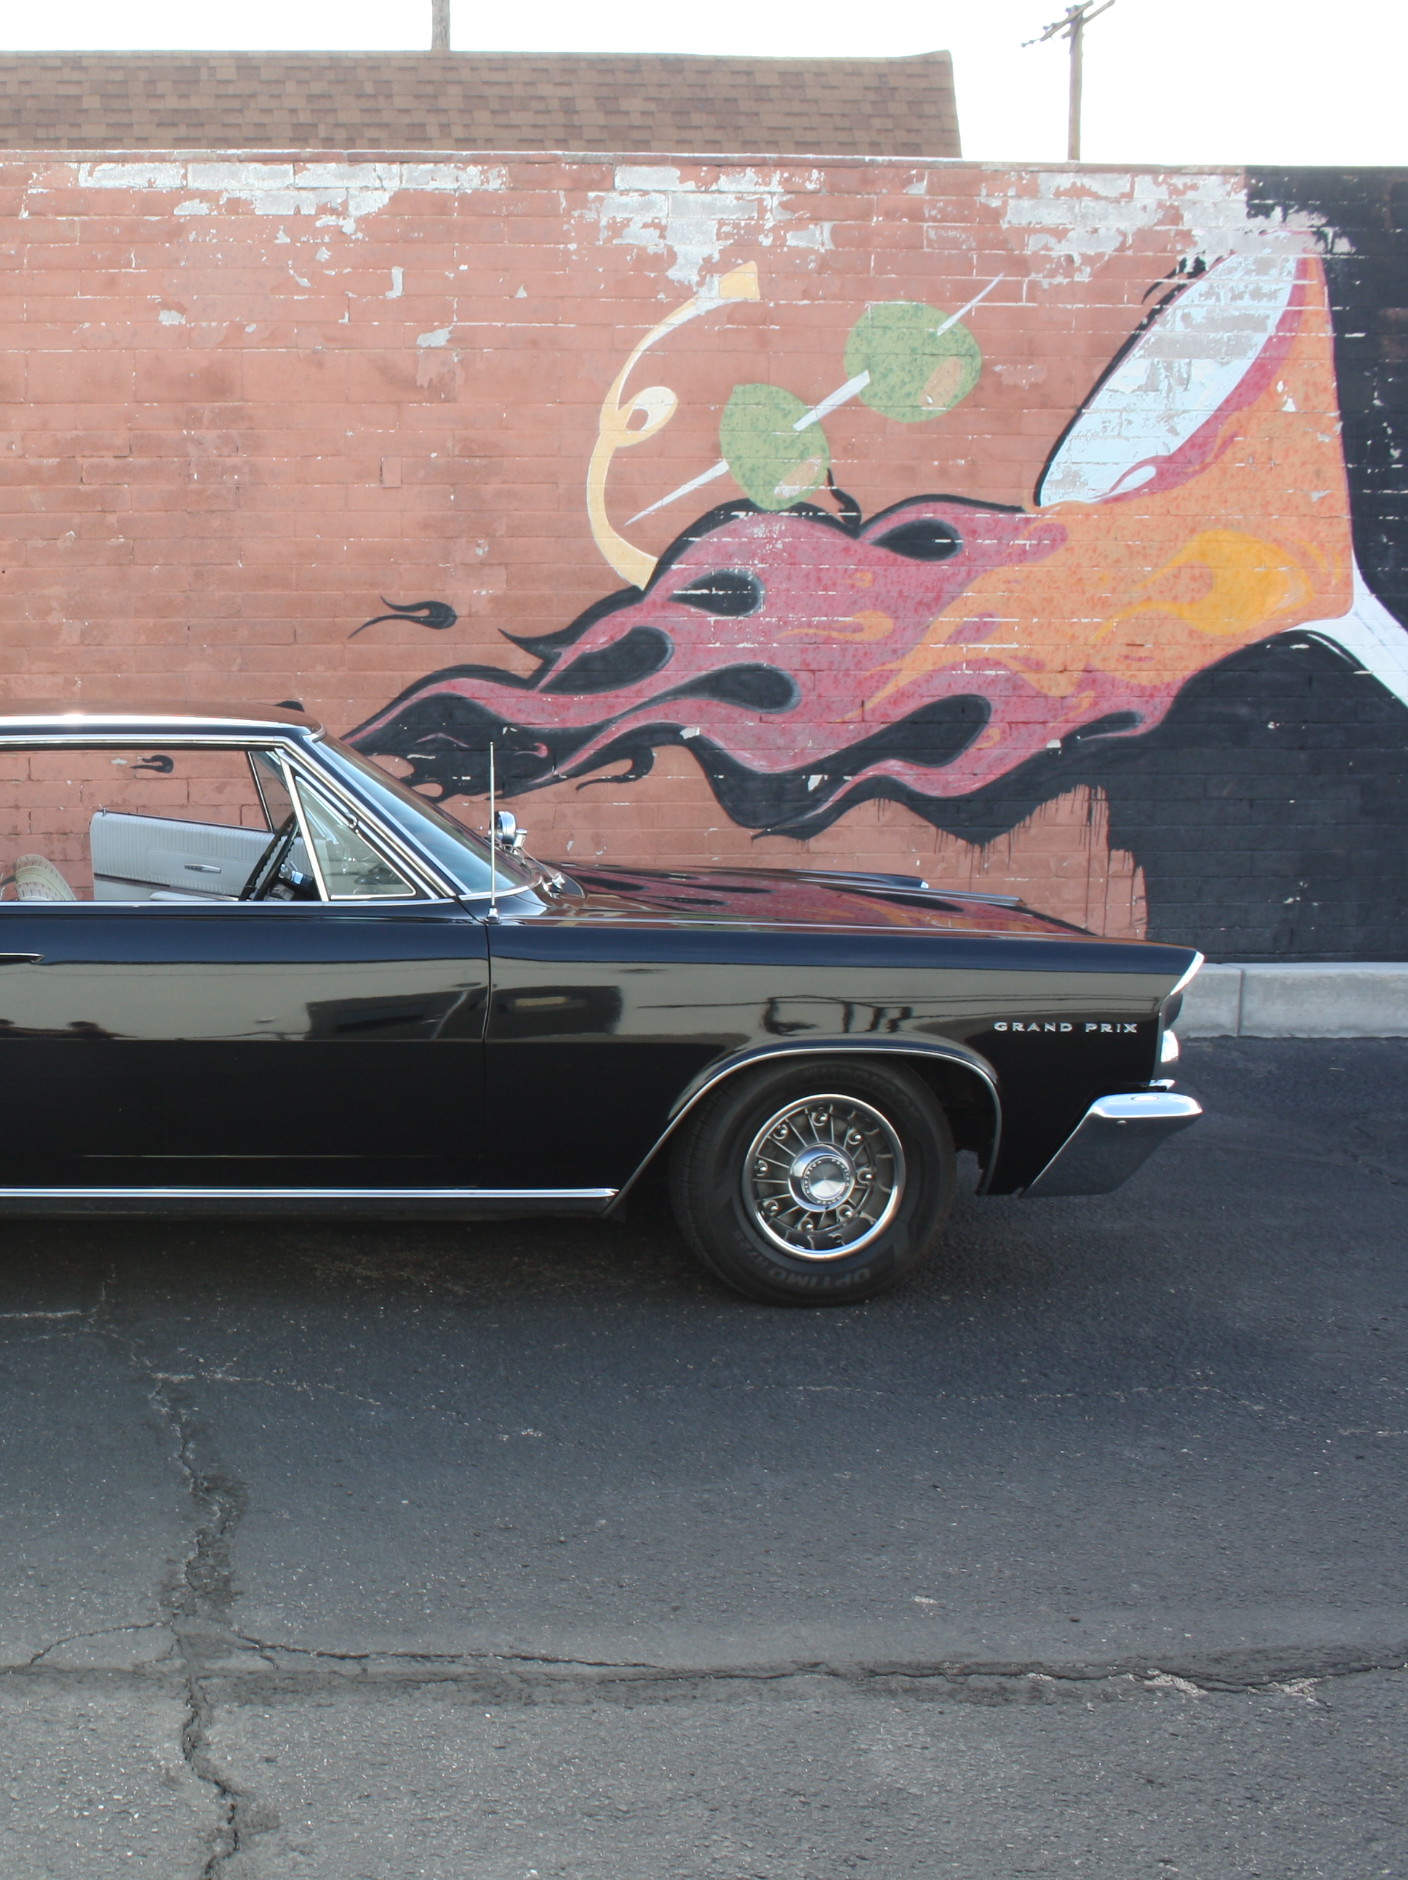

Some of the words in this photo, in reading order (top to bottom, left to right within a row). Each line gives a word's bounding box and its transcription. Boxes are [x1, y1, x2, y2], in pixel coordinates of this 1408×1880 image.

[993, 1021, 1073, 1033] GRAND
[1085, 1022, 1138, 1034] PRIX
[768, 1267, 871, 1288] OPTIMO
